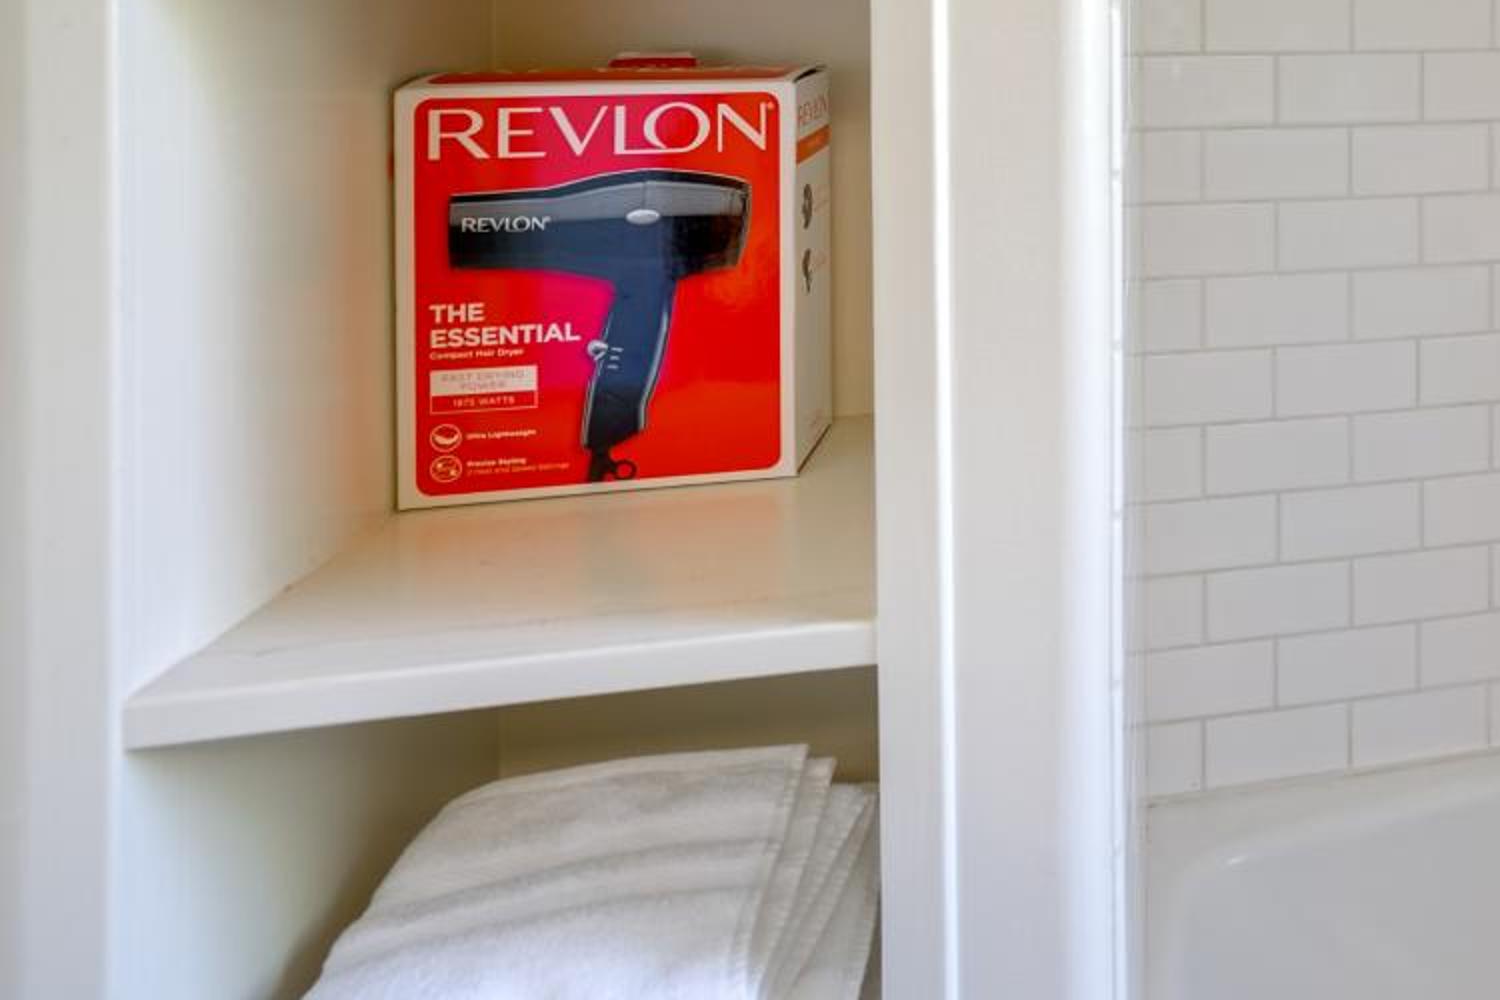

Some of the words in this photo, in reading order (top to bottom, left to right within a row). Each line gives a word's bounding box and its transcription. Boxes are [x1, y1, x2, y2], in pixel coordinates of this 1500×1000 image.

[427, 101, 768, 161] REVLON
[461, 215, 549, 234] REVLON
[429, 302, 486, 324] THE
[430, 322, 582, 349] ESSENTIAL
[429, 349, 474, 361] Compact
[476, 348, 495, 359] Hair
[497, 347, 525, 358] Dryer
[478, 395, 516, 406] WATTS
